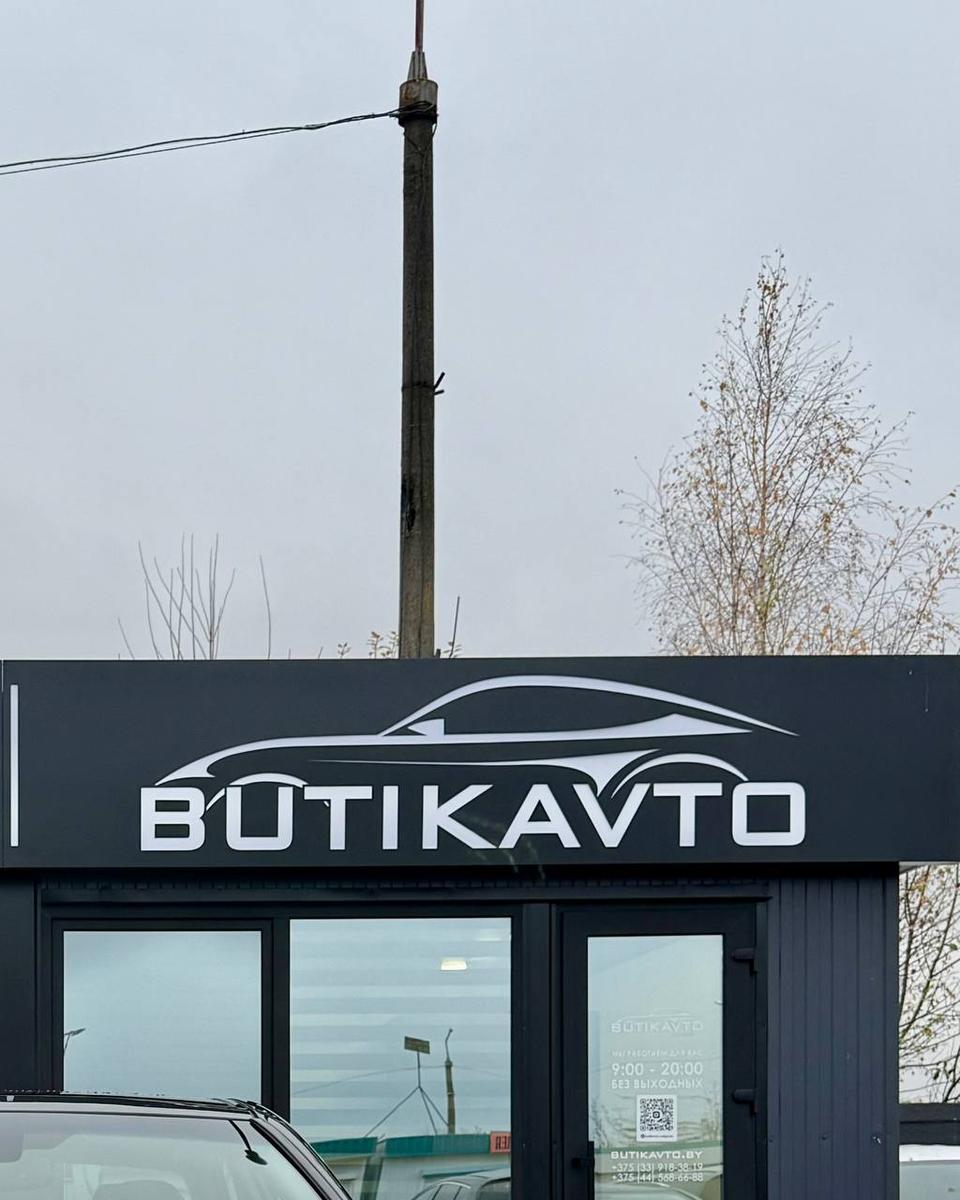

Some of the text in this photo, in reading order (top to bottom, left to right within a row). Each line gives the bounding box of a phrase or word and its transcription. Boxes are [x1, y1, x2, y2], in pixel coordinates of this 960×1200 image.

[140, 781, 806, 852] BUTIKAVTO
[611, 1021, 704, 1033] BUTIKAVTO
[611, 1063, 644, 1076] 9:00
[660, 1062, 704, 1076] 20:00
[611, 1079, 704, 1089] БЕЗ ВЫХОДНЫХ
[611, 1151, 703, 1159] BUTIKAVTO.BY
[612, 1163, 703, 1173] +375 (33) 918-38-19
[612, 1173, 704, 1183] +375 (44) 568-66-88
